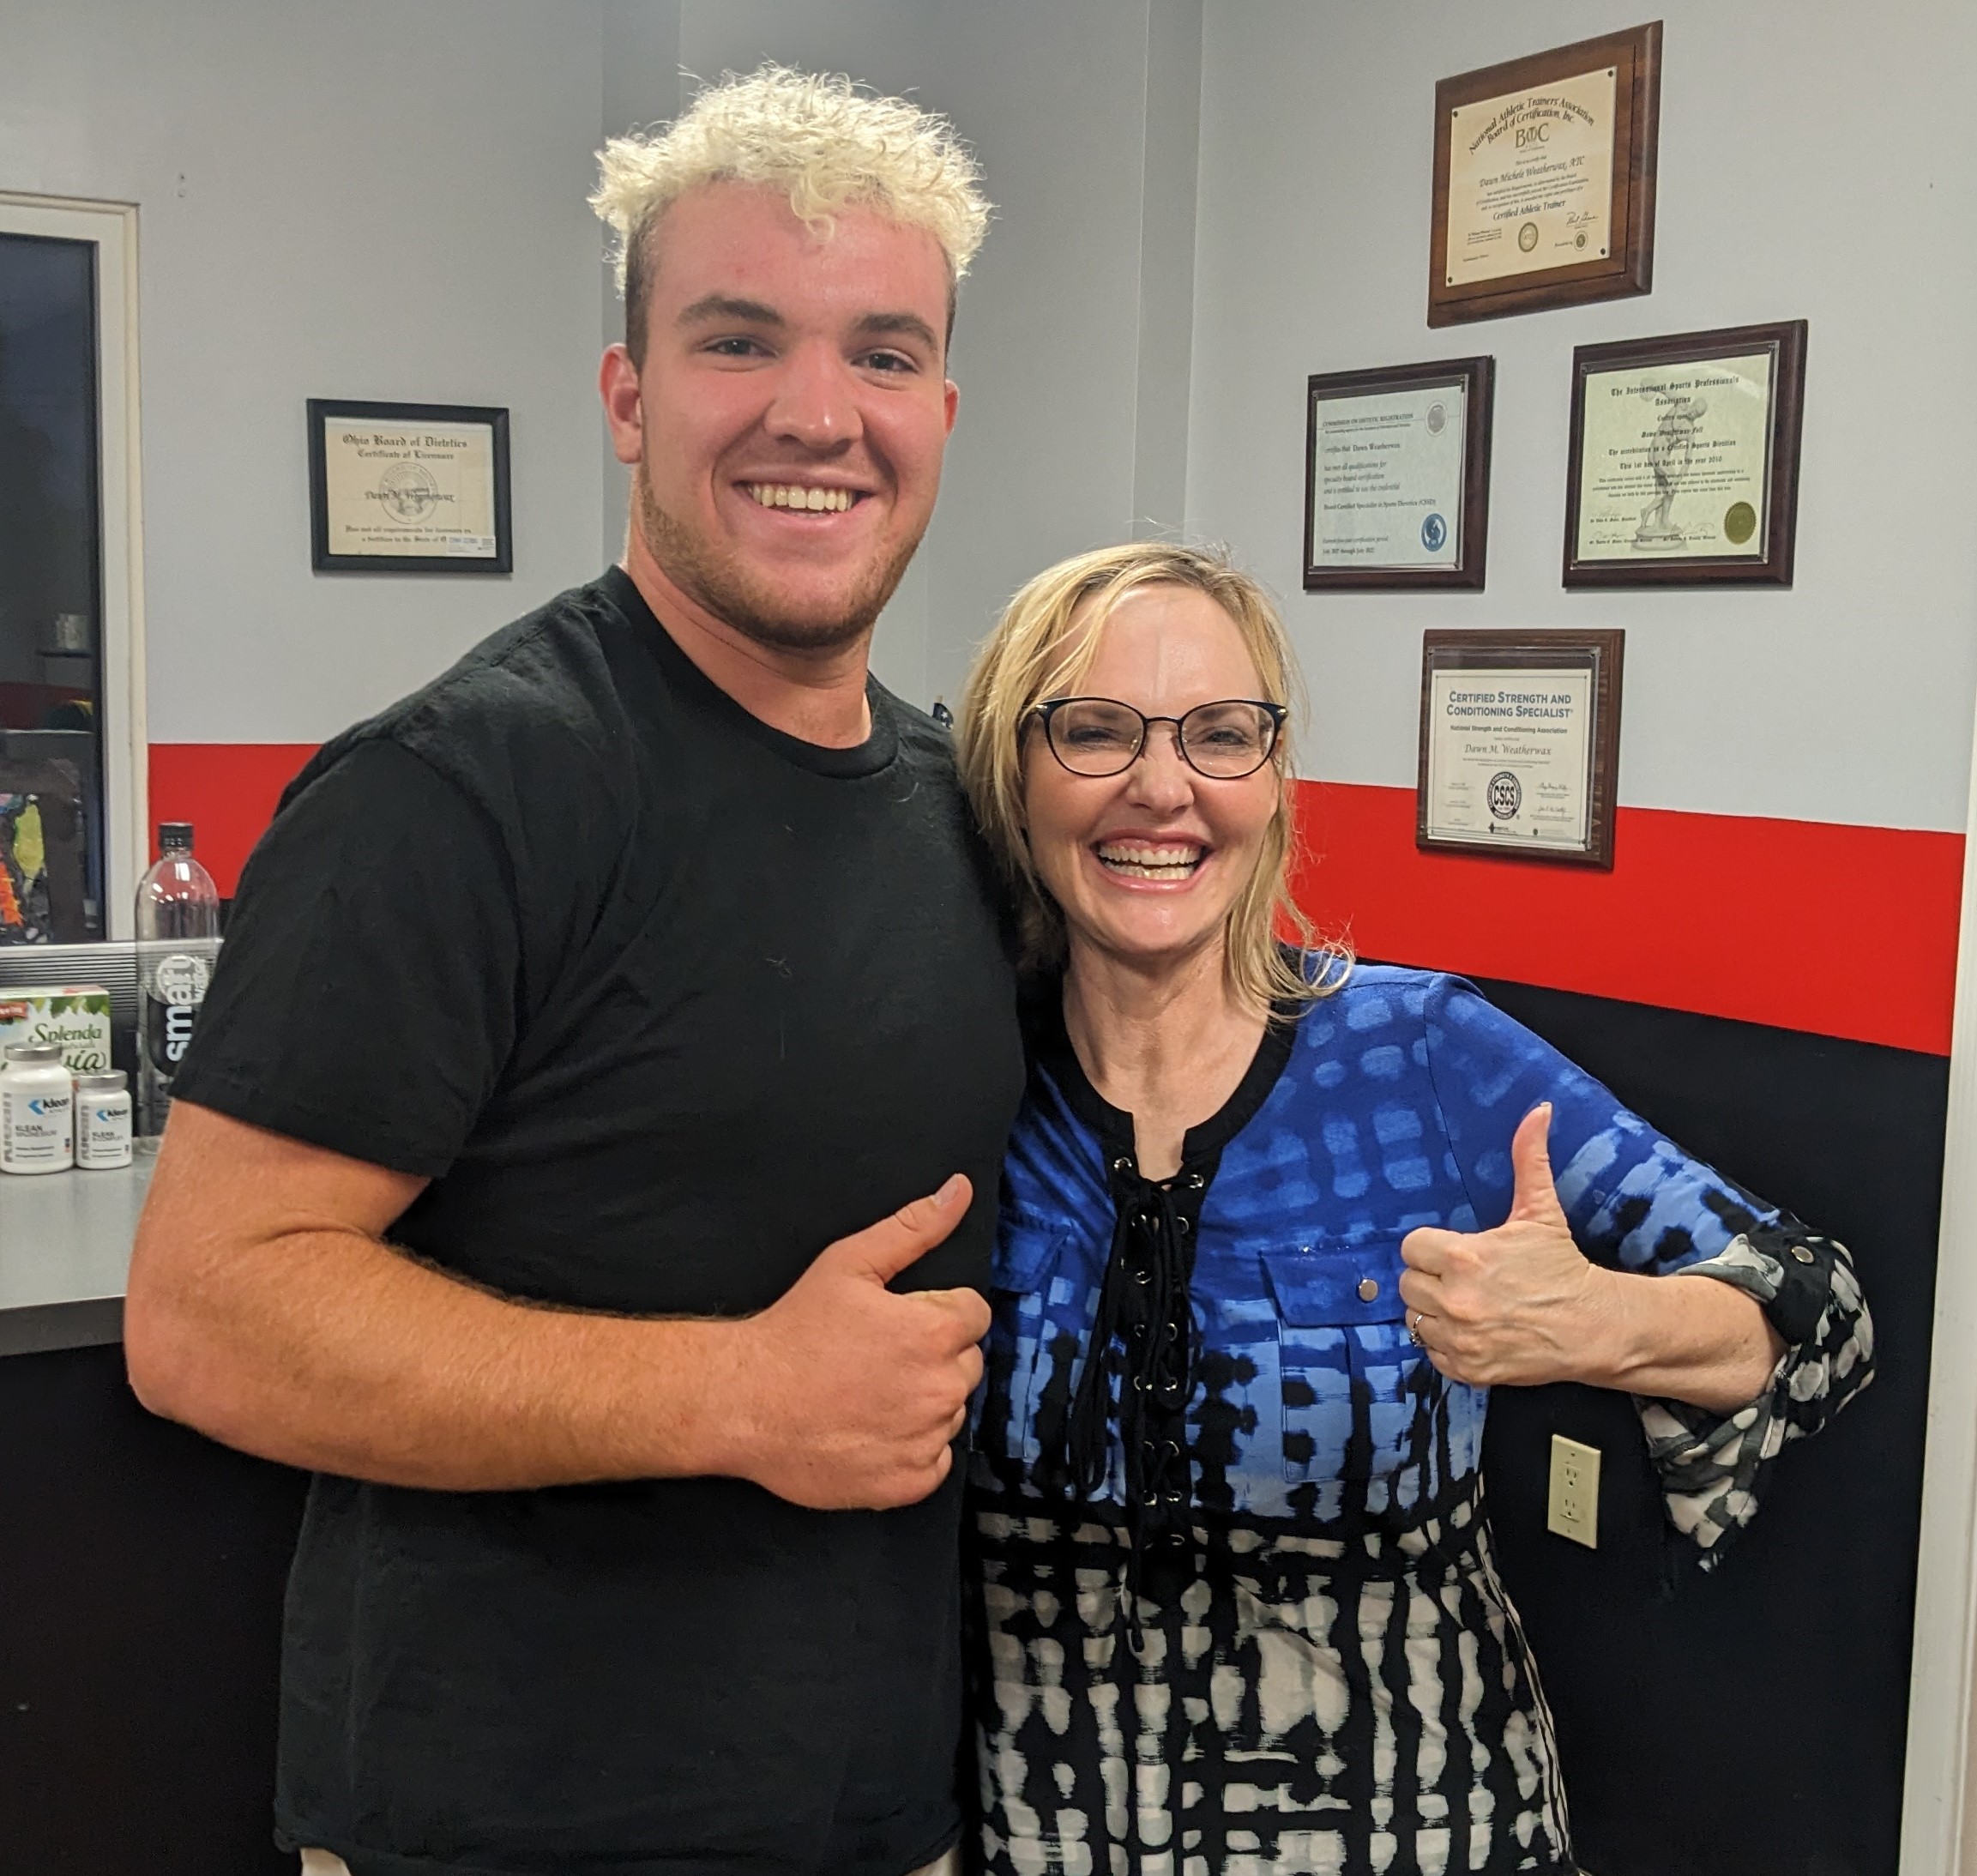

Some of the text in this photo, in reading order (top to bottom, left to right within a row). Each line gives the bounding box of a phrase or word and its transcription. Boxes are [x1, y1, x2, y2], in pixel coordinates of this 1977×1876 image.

[1469, 117, 1498, 154] National
[1498, 101, 1525, 124] Athletic
[1559, 98, 1594, 126] Association
[1487, 119, 1509, 144] Board
[1479, 178, 1498, 187] Dawn
[1493, 200, 1566, 220] Certified Athletic Trainer
[1611, 376, 1739, 397] The International Sports Professionals
[1655, 396, 1691, 406] Association
[343, 434, 467, 448] Ohio Board of Dietetics
[1691, 441, 1710, 449] Sports
[358, 449, 455, 460] Certificate of Licensure
[1662, 458, 1676, 467] April
[1450, 691, 1571, 704] CERTIFIED STRENGTH AND
[1446, 703, 1513, 717] CONDITIONING
[1504, 726, 1536, 734] Conditioning
[1465, 744, 1552, 756] Dawn M. Weatherwax
[1493, 785, 1515, 806] CSCS
[166, 955, 193, 1061] smart
[28, 1022, 103, 1044] Splenda
